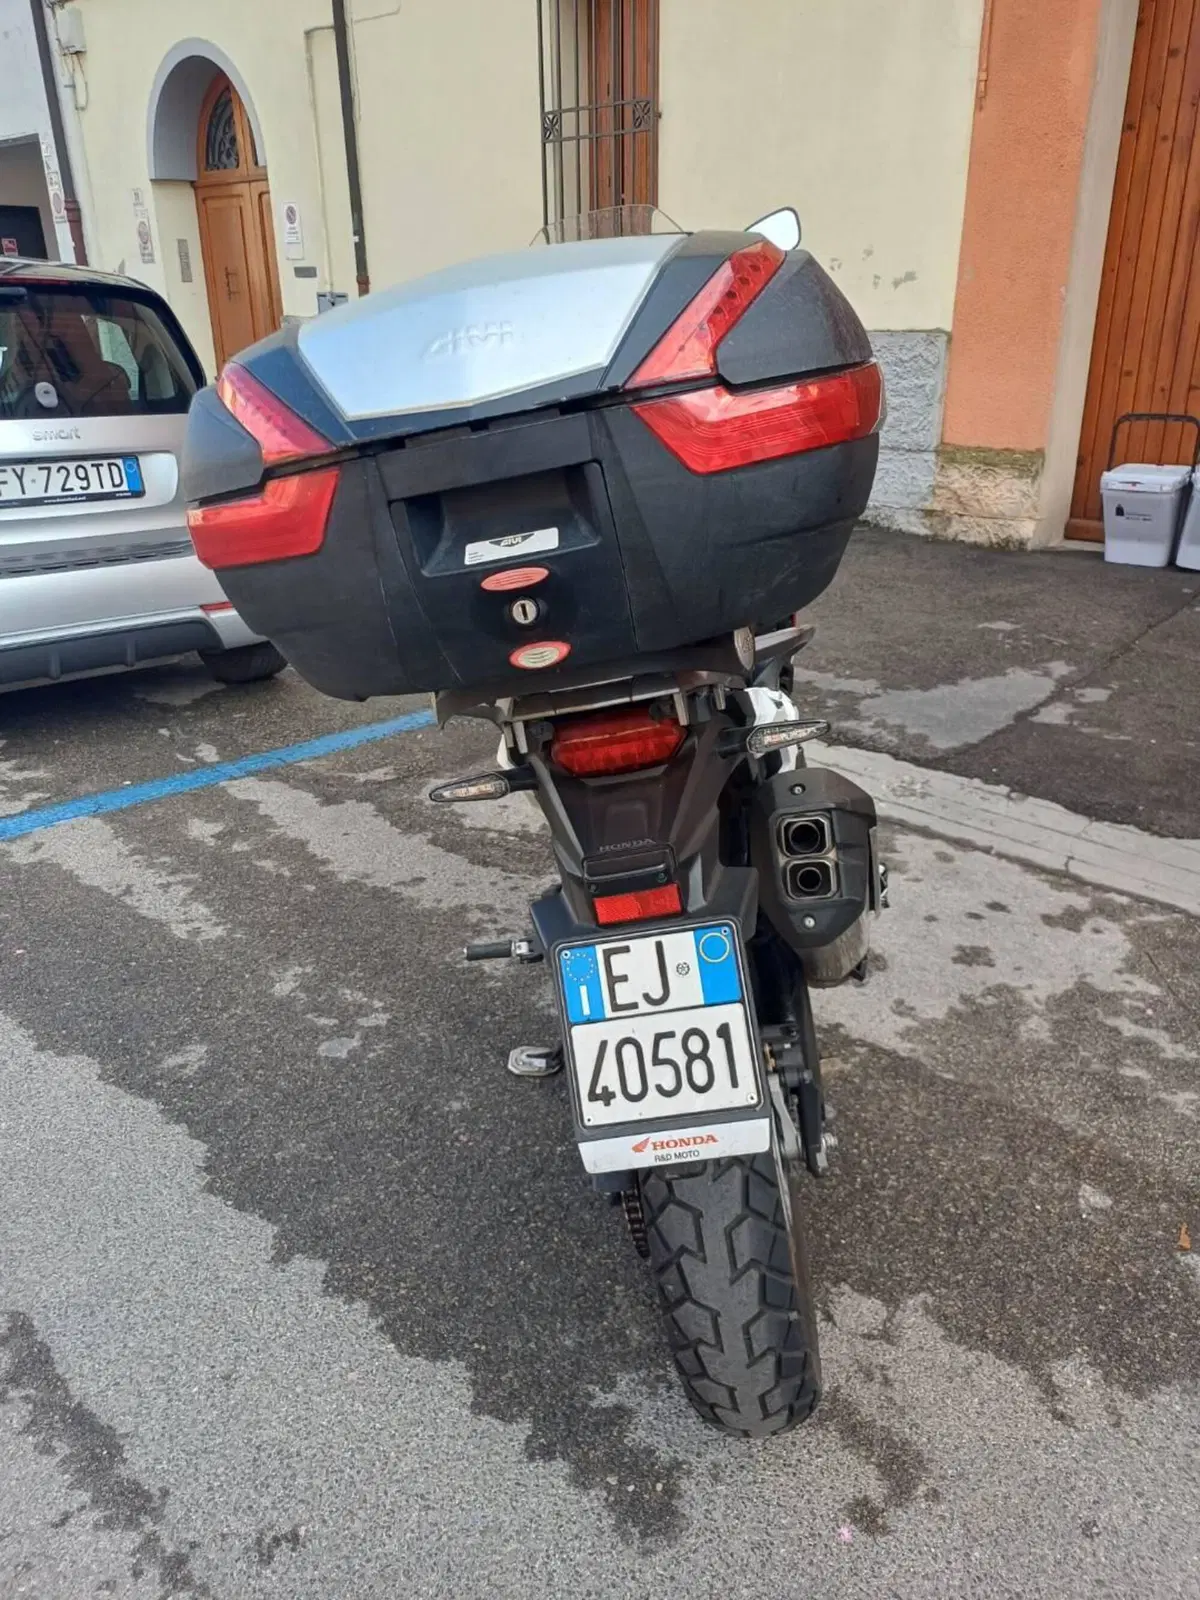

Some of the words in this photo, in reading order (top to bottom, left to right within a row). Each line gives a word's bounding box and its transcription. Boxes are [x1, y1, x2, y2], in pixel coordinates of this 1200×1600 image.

[32, 426, 81, 441] smart
[38, 462, 124, 494] 729TD
[600, 838, 656, 852] HONDA
[602, 940, 671, 1012] EJ
[587, 1022, 739, 1107] 40581
[651, 1134, 719, 1151] HONDA
[654, 1153, 672, 1163] R&D
[673, 1149, 700, 1160] MOTO
